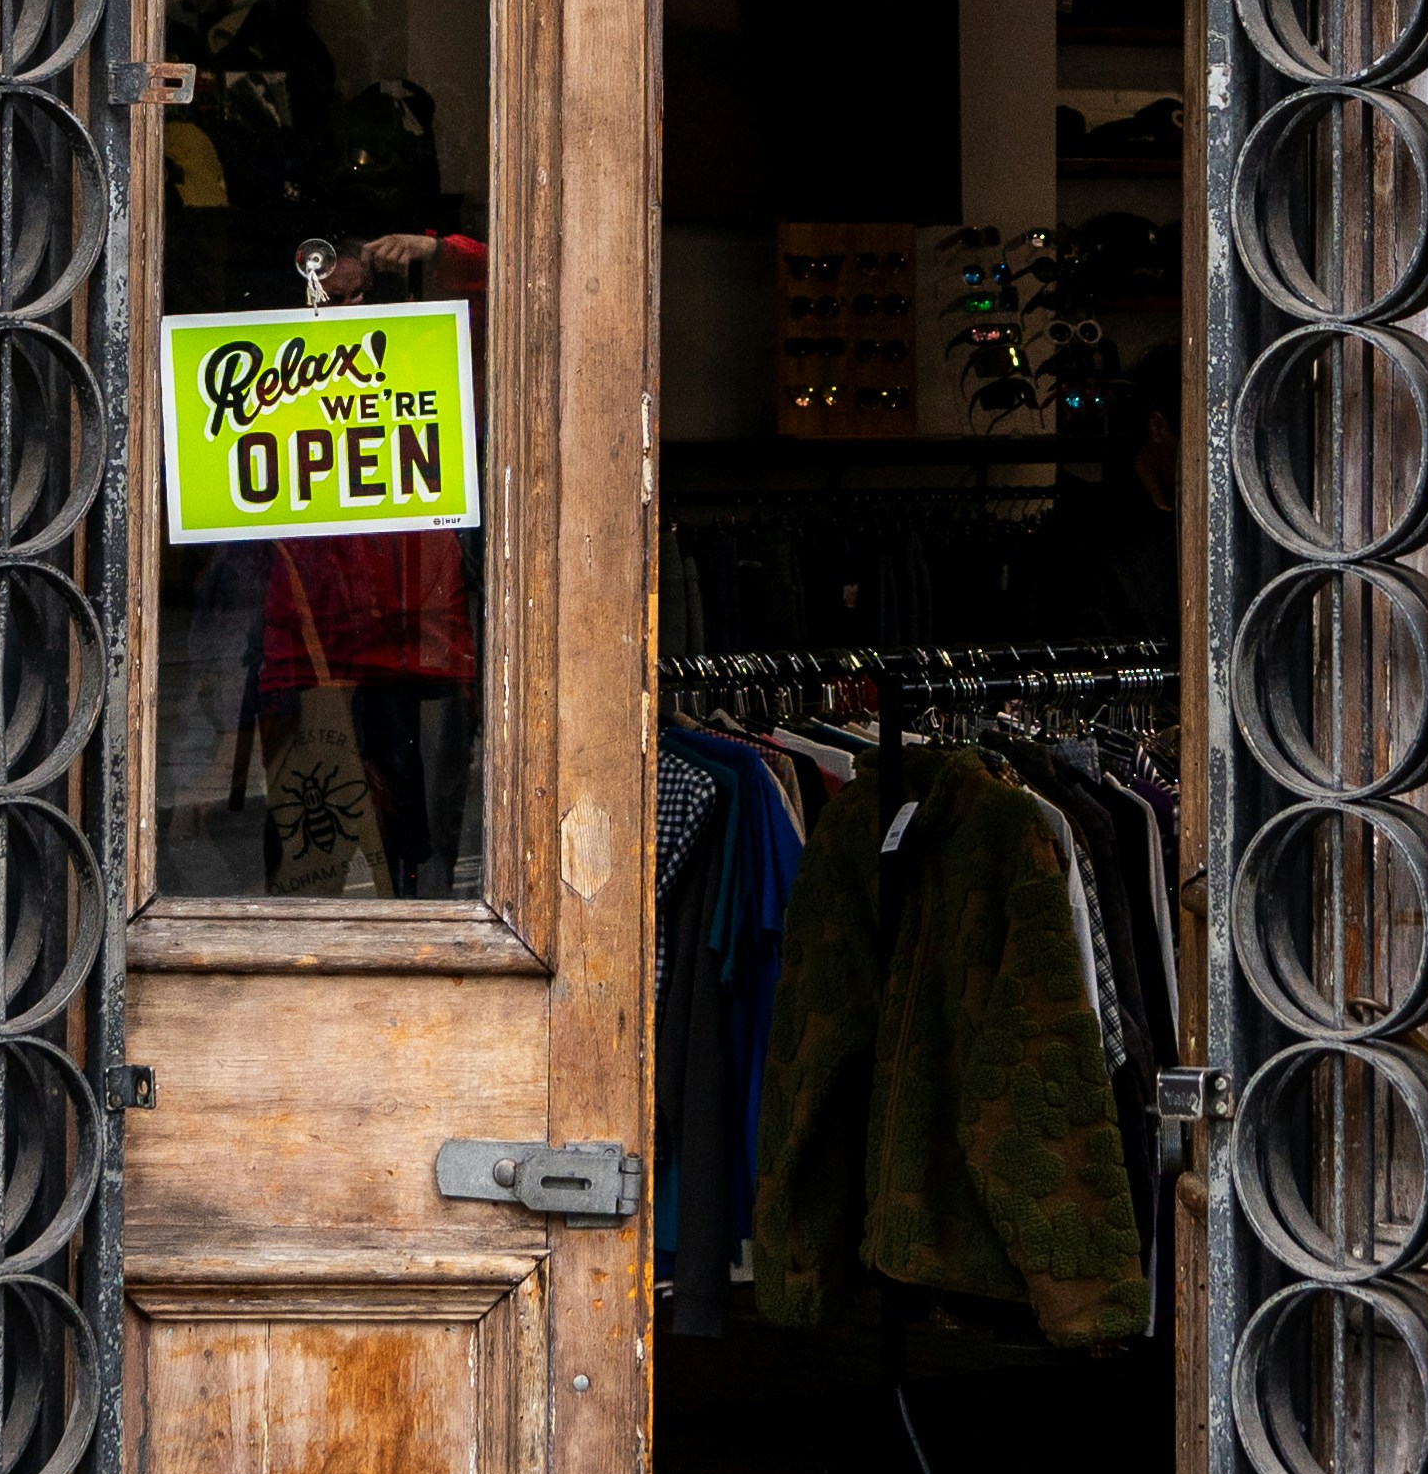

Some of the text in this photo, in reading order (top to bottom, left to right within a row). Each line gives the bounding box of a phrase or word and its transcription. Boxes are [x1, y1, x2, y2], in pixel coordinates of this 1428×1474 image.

[199, 329, 388, 441] Relax!
[319, 388, 438, 424] WE'RE
[228, 422, 442, 513] OPEN
